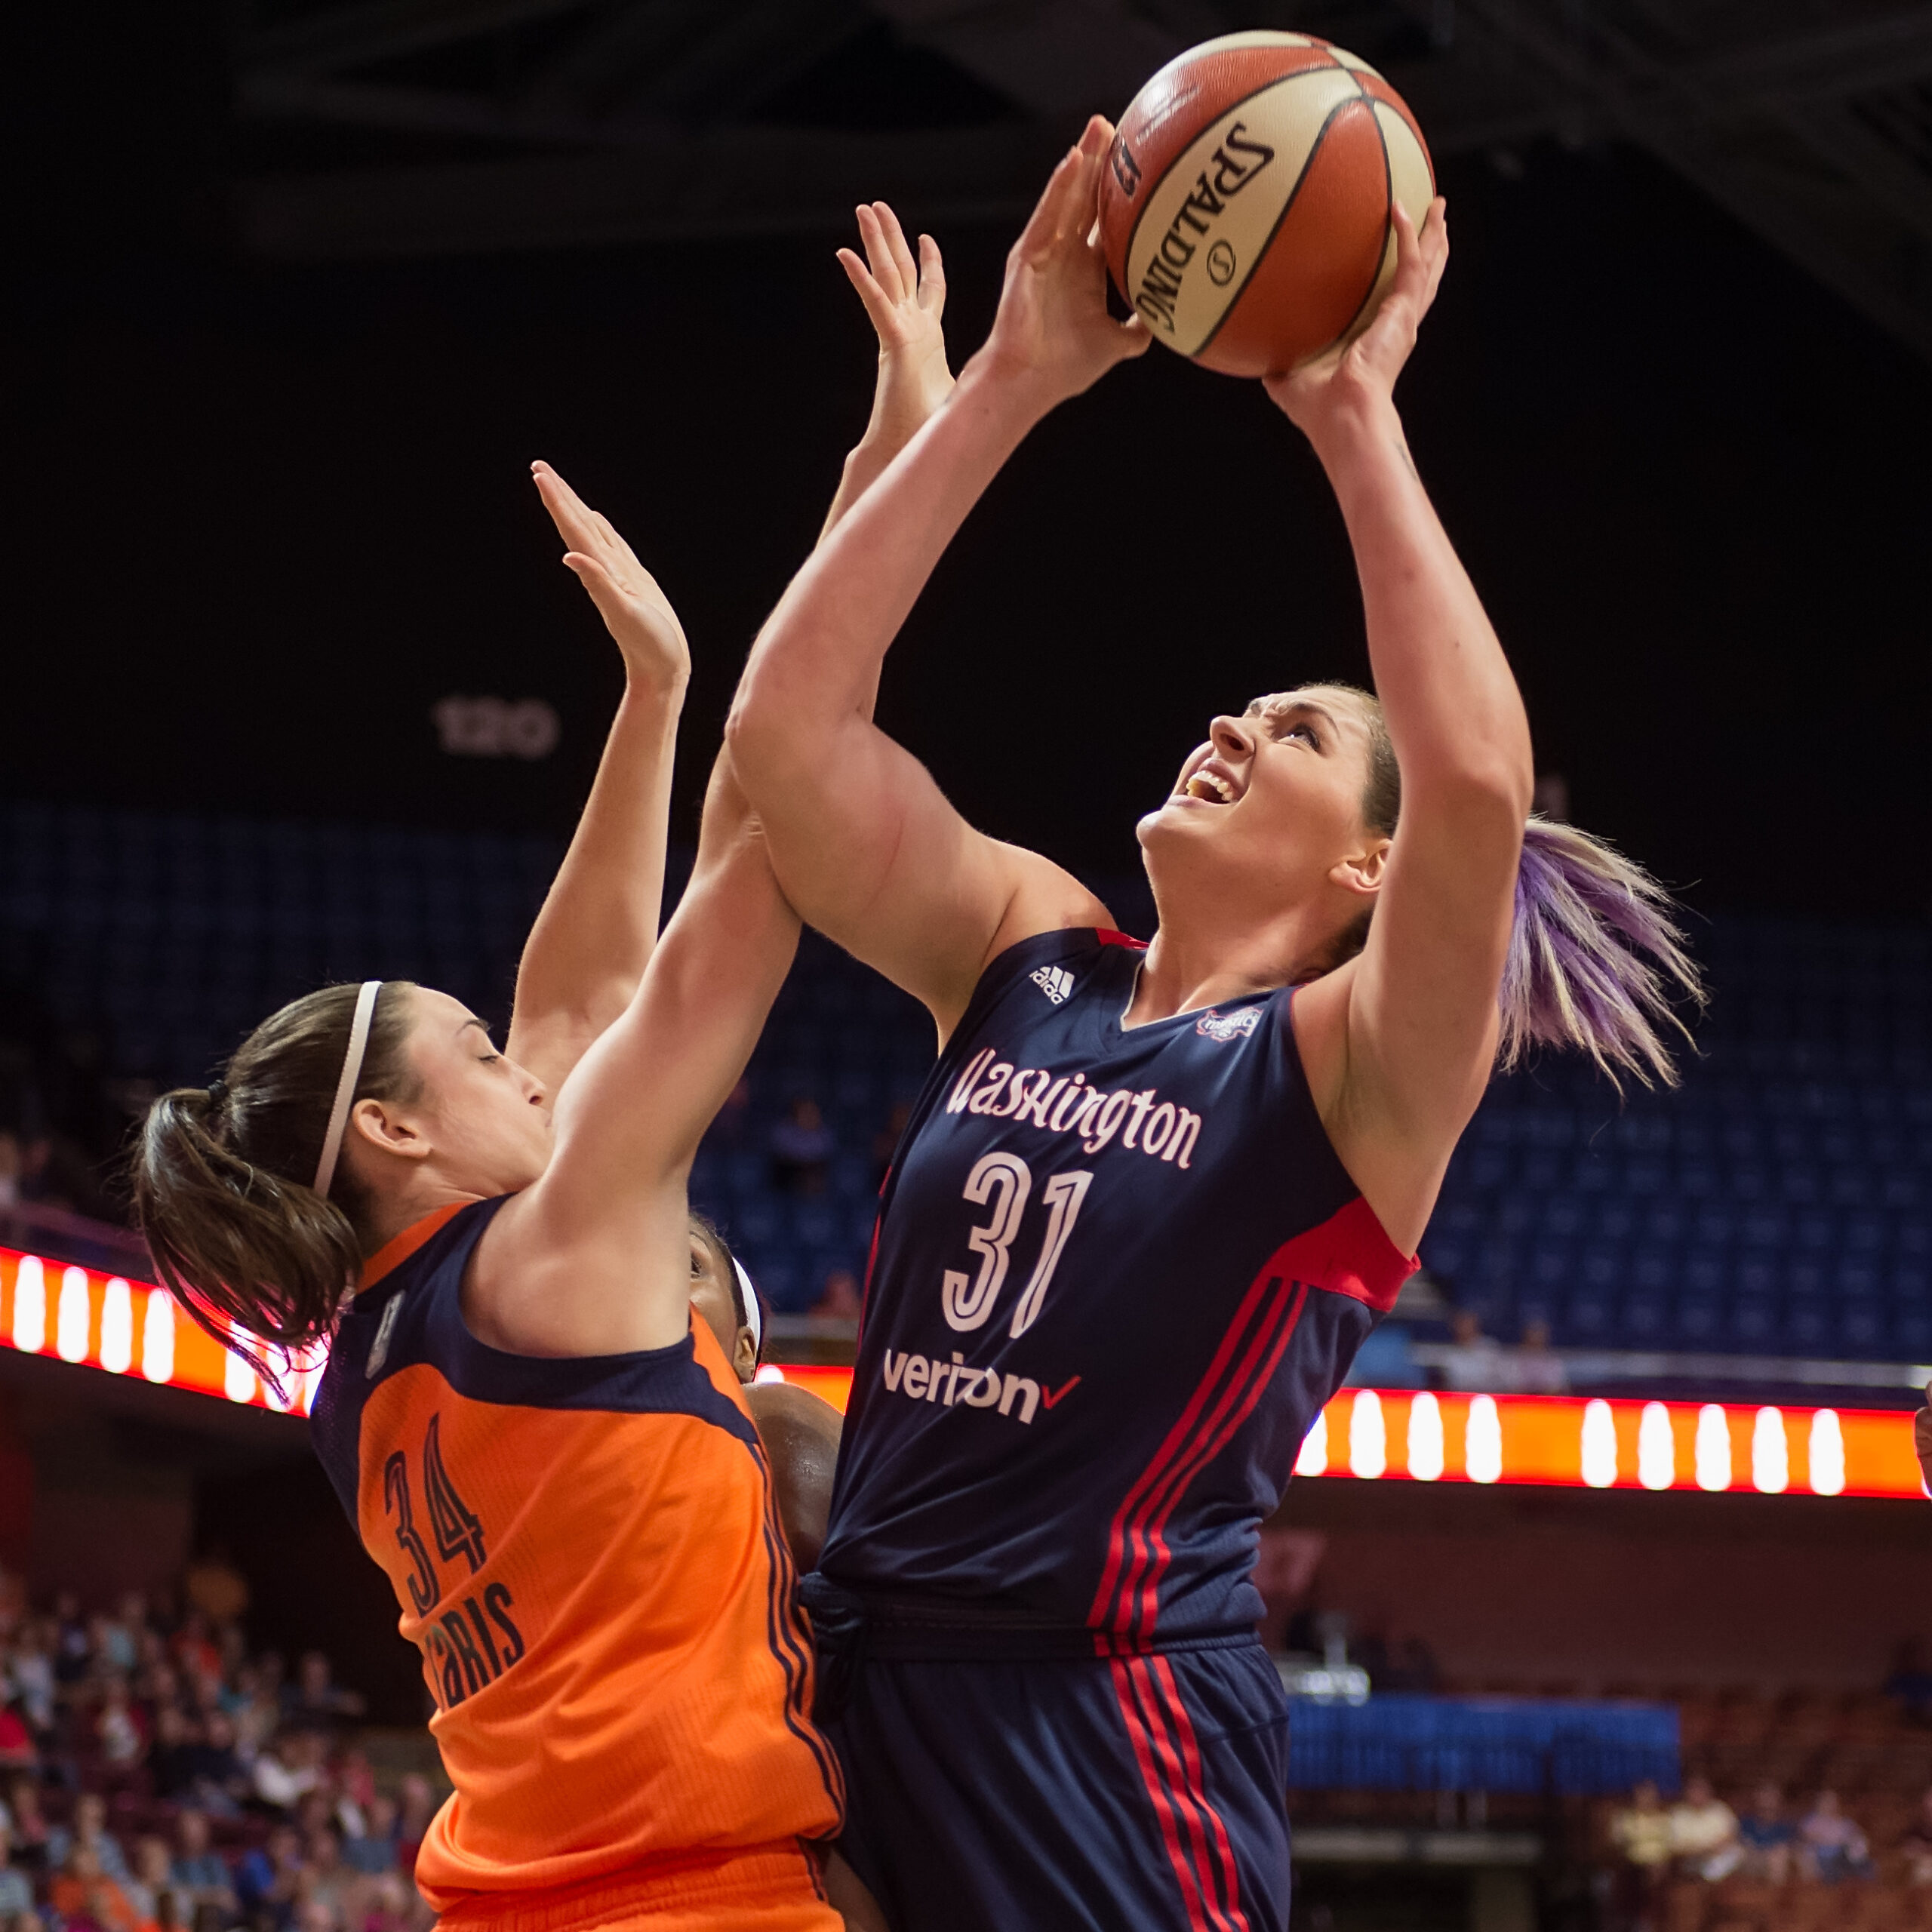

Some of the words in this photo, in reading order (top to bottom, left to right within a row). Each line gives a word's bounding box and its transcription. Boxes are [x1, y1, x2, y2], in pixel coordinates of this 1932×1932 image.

[1136, 121, 1275, 335] SPALDING
[432, 696, 560, 758] 120
[941, 1151, 1094, 1340] 31
[883, 1348, 1041, 1425] verizon
[385, 1411, 488, 1619] 34
